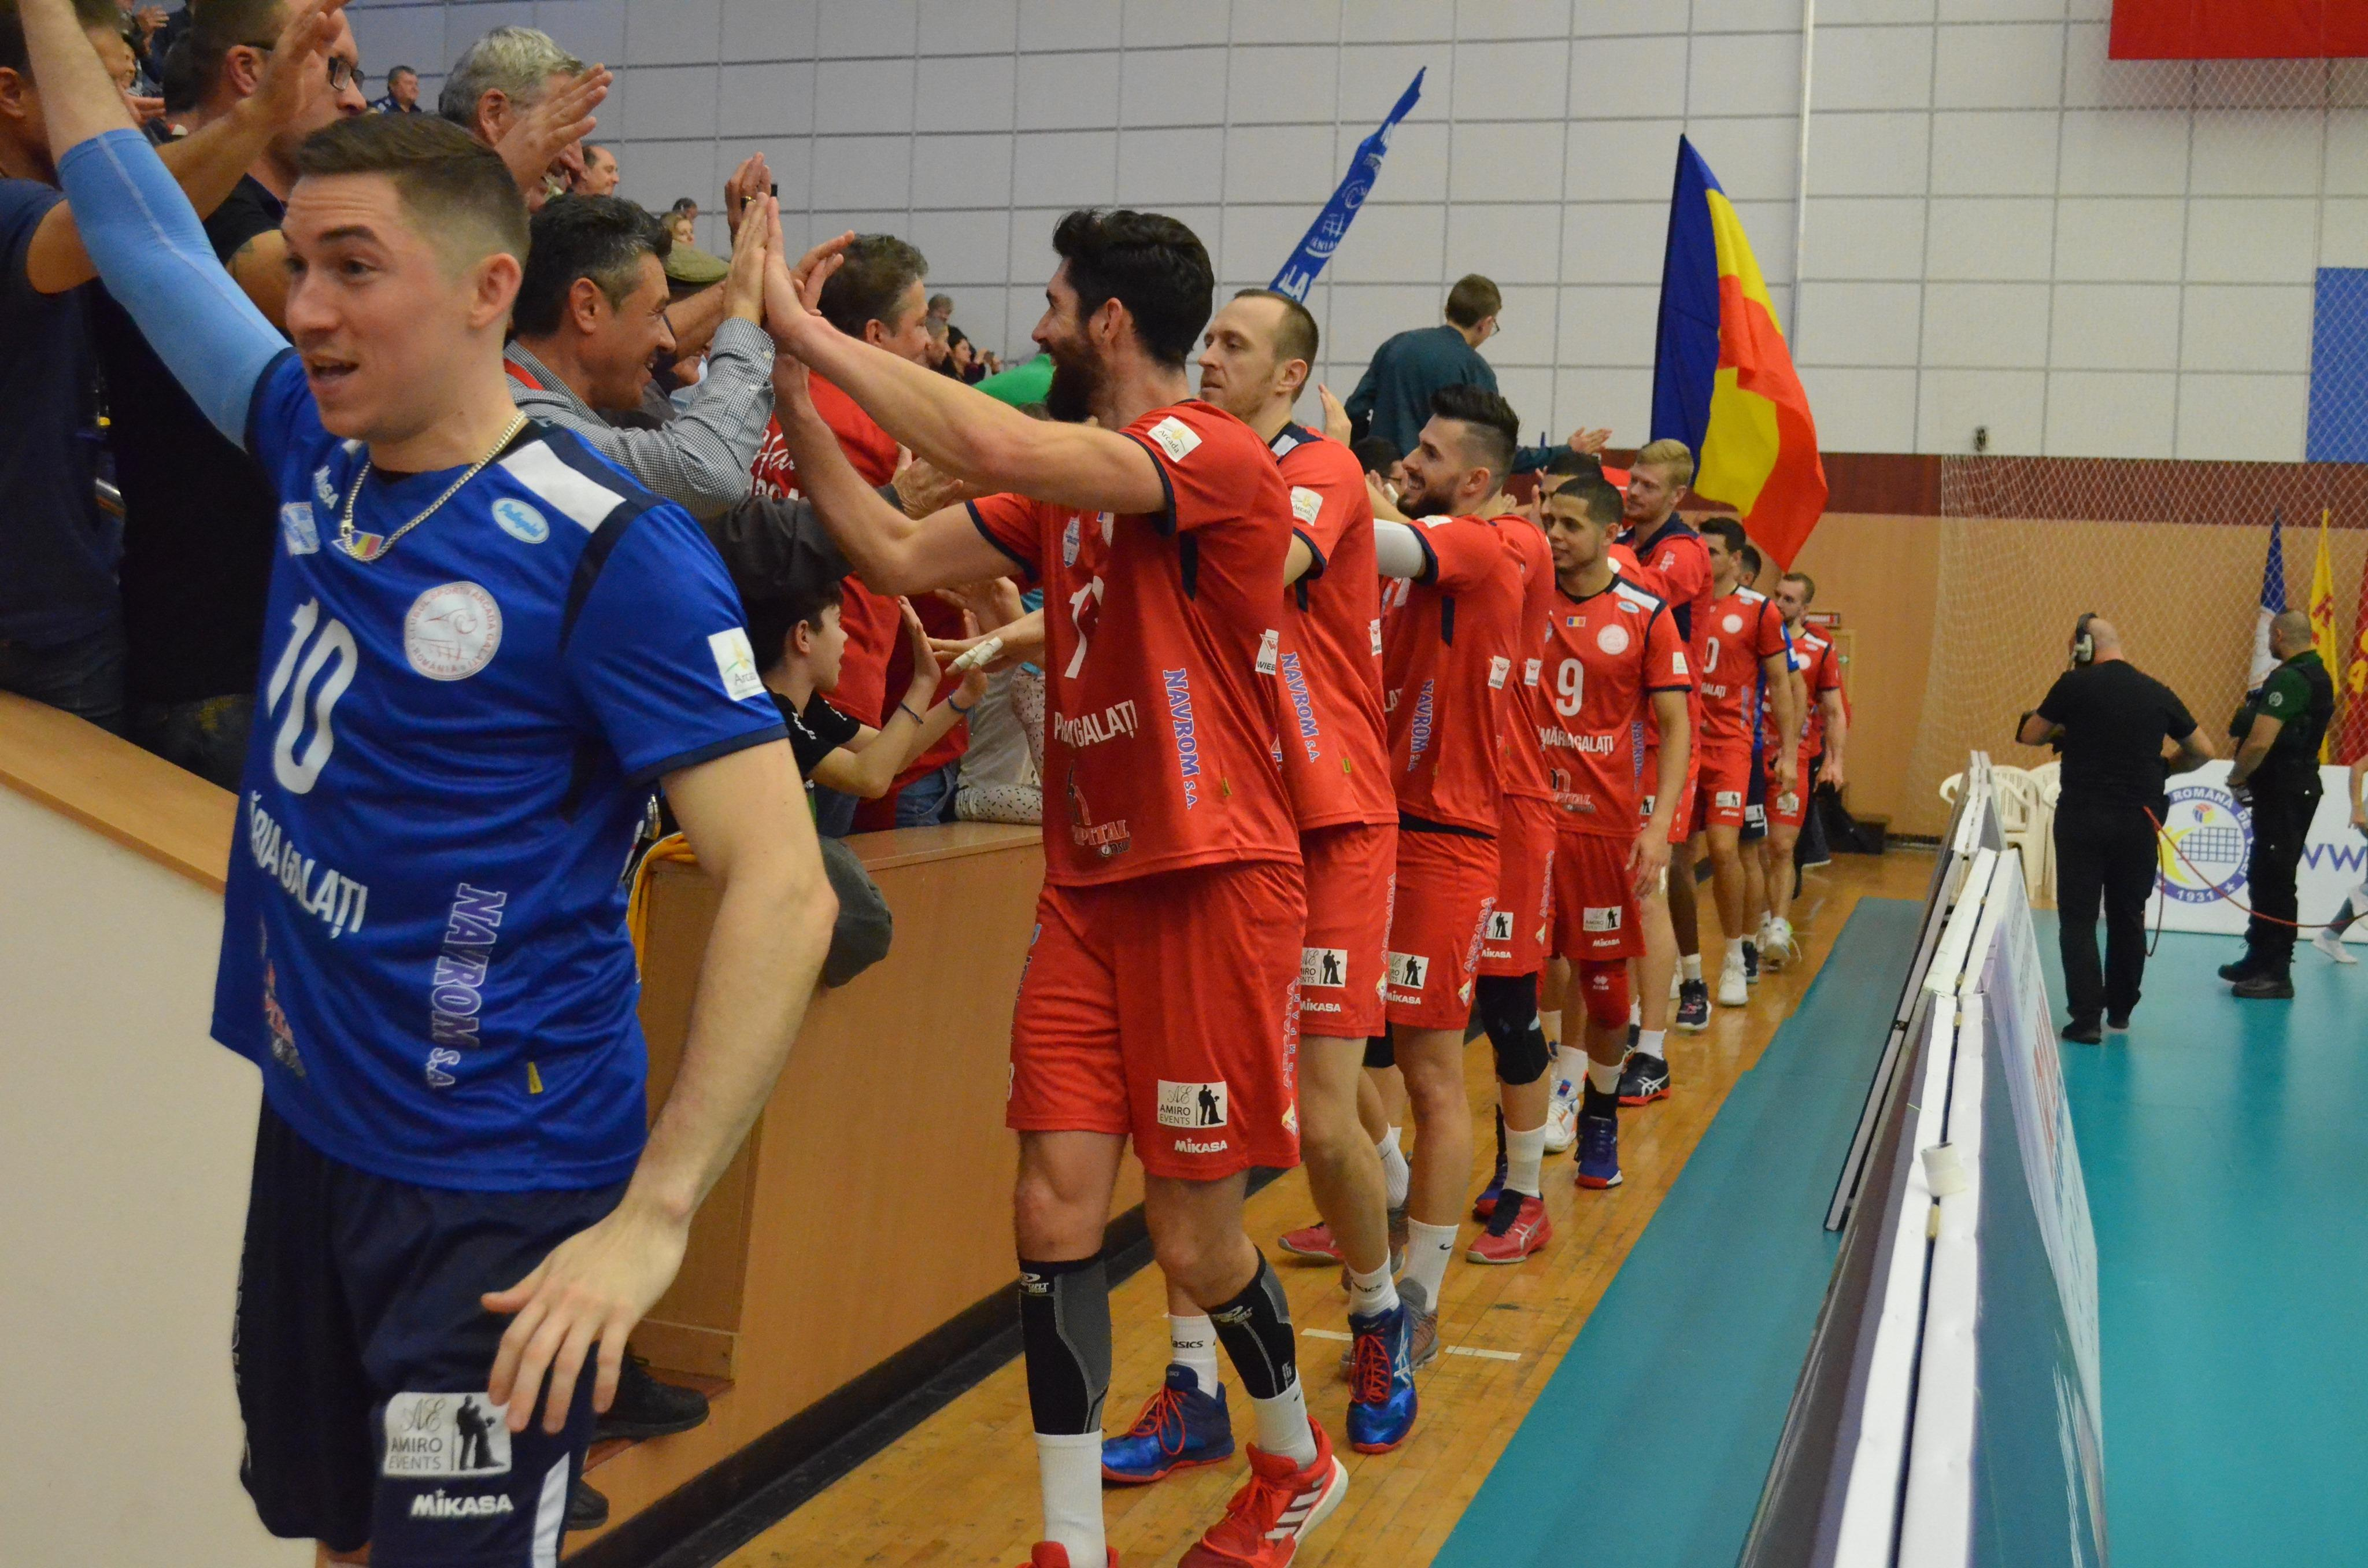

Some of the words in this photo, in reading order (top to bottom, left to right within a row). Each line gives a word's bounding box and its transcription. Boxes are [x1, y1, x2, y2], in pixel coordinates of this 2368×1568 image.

[1158, 430, 1179, 454] Arcada
[268, 596, 358, 794] 10
[1279, 651, 1319, 738] NAVROM
[1556, 657, 1584, 716] 9
[1410, 678, 1434, 753] NAVROM
[1163, 668, 1201, 777] NAVROM
[1183, 780, 1197, 810] S.A.
[2177, 890, 2215, 903] 1931
[1301, 967, 1316, 976] IRO
[1160, 1104, 1191, 1116] AMIRO
[1160, 1114, 1190, 1125] EVENTS
[391, 1437, 443, 1453] AMIRO
[388, 1456, 441, 1471] EVENTS
